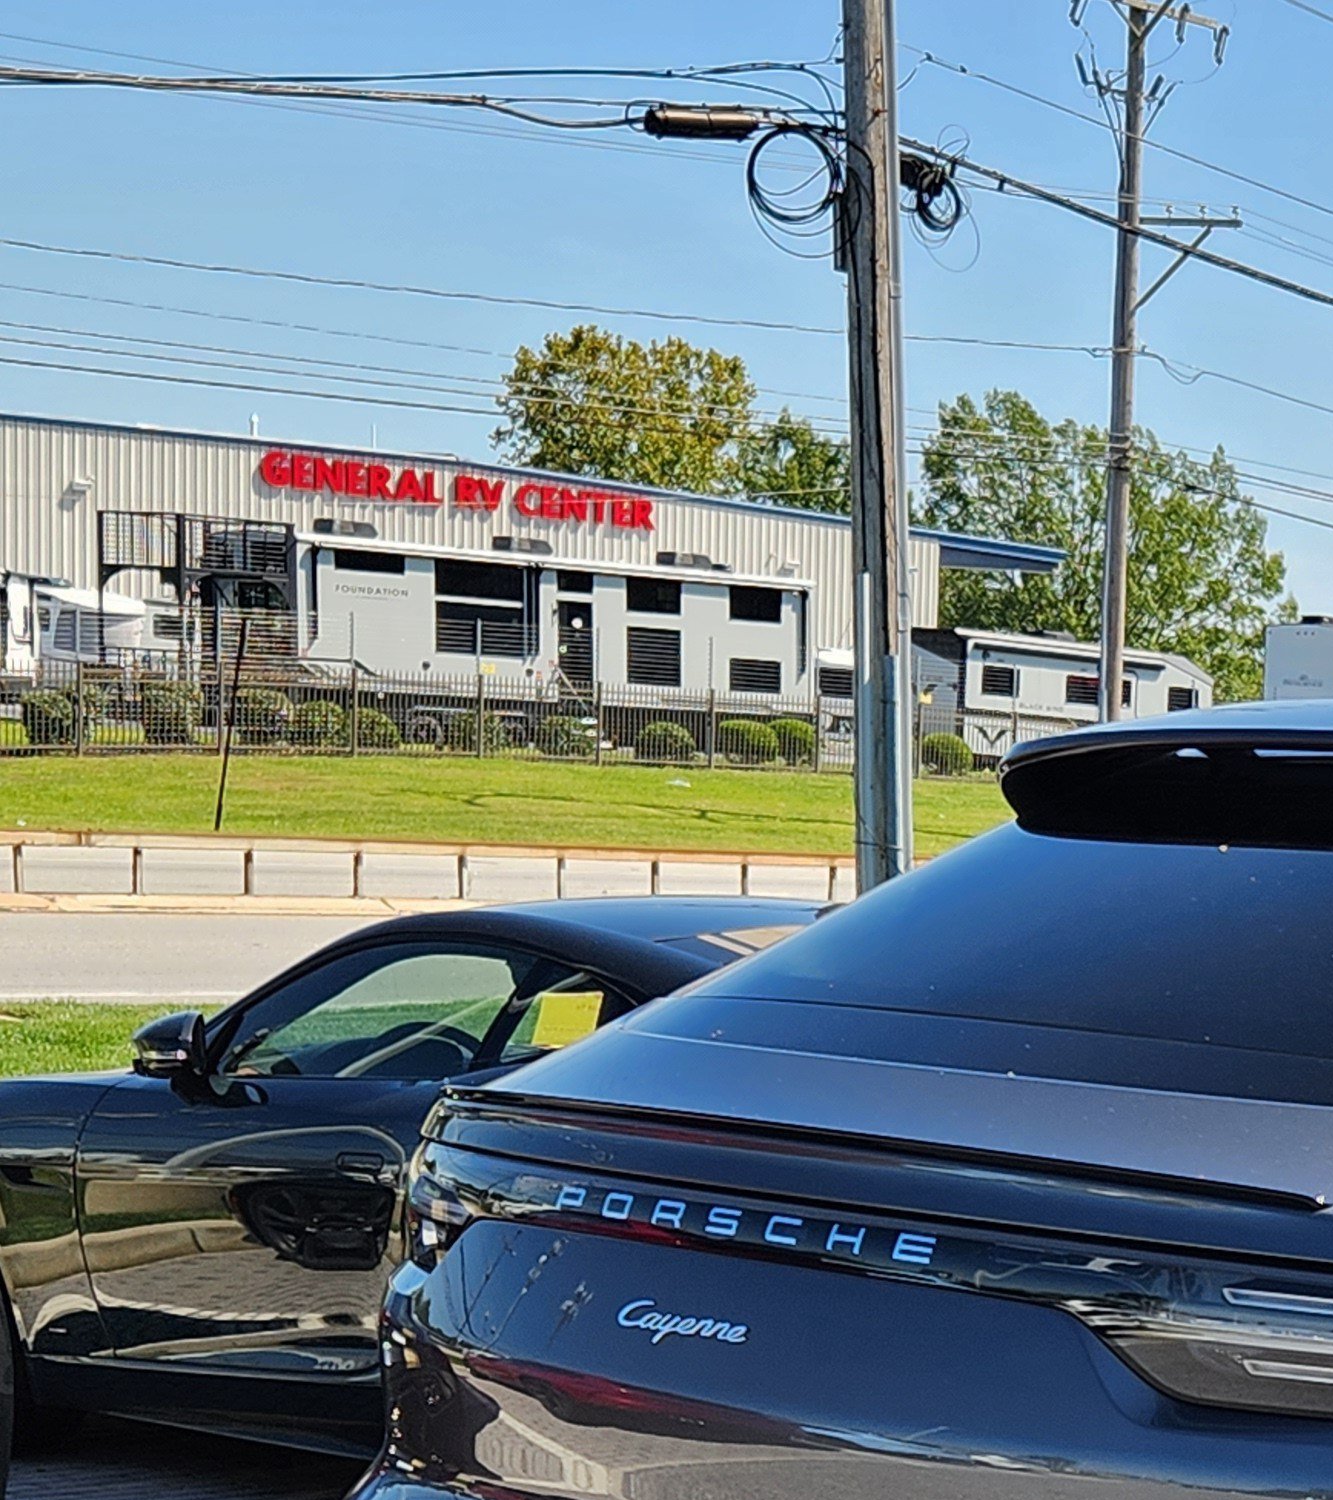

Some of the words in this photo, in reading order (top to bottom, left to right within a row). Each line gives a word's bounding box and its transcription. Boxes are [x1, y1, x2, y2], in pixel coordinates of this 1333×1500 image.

[260, 451, 444, 504] GENERAL
[454, 475, 504, 511] RV
[514, 484, 655, 530] CENTER
[334, 583, 409, 597] FOUNDATION
[556, 1186, 937, 1265] PORSCHE
[618, 1299, 748, 1344] Cayenne
